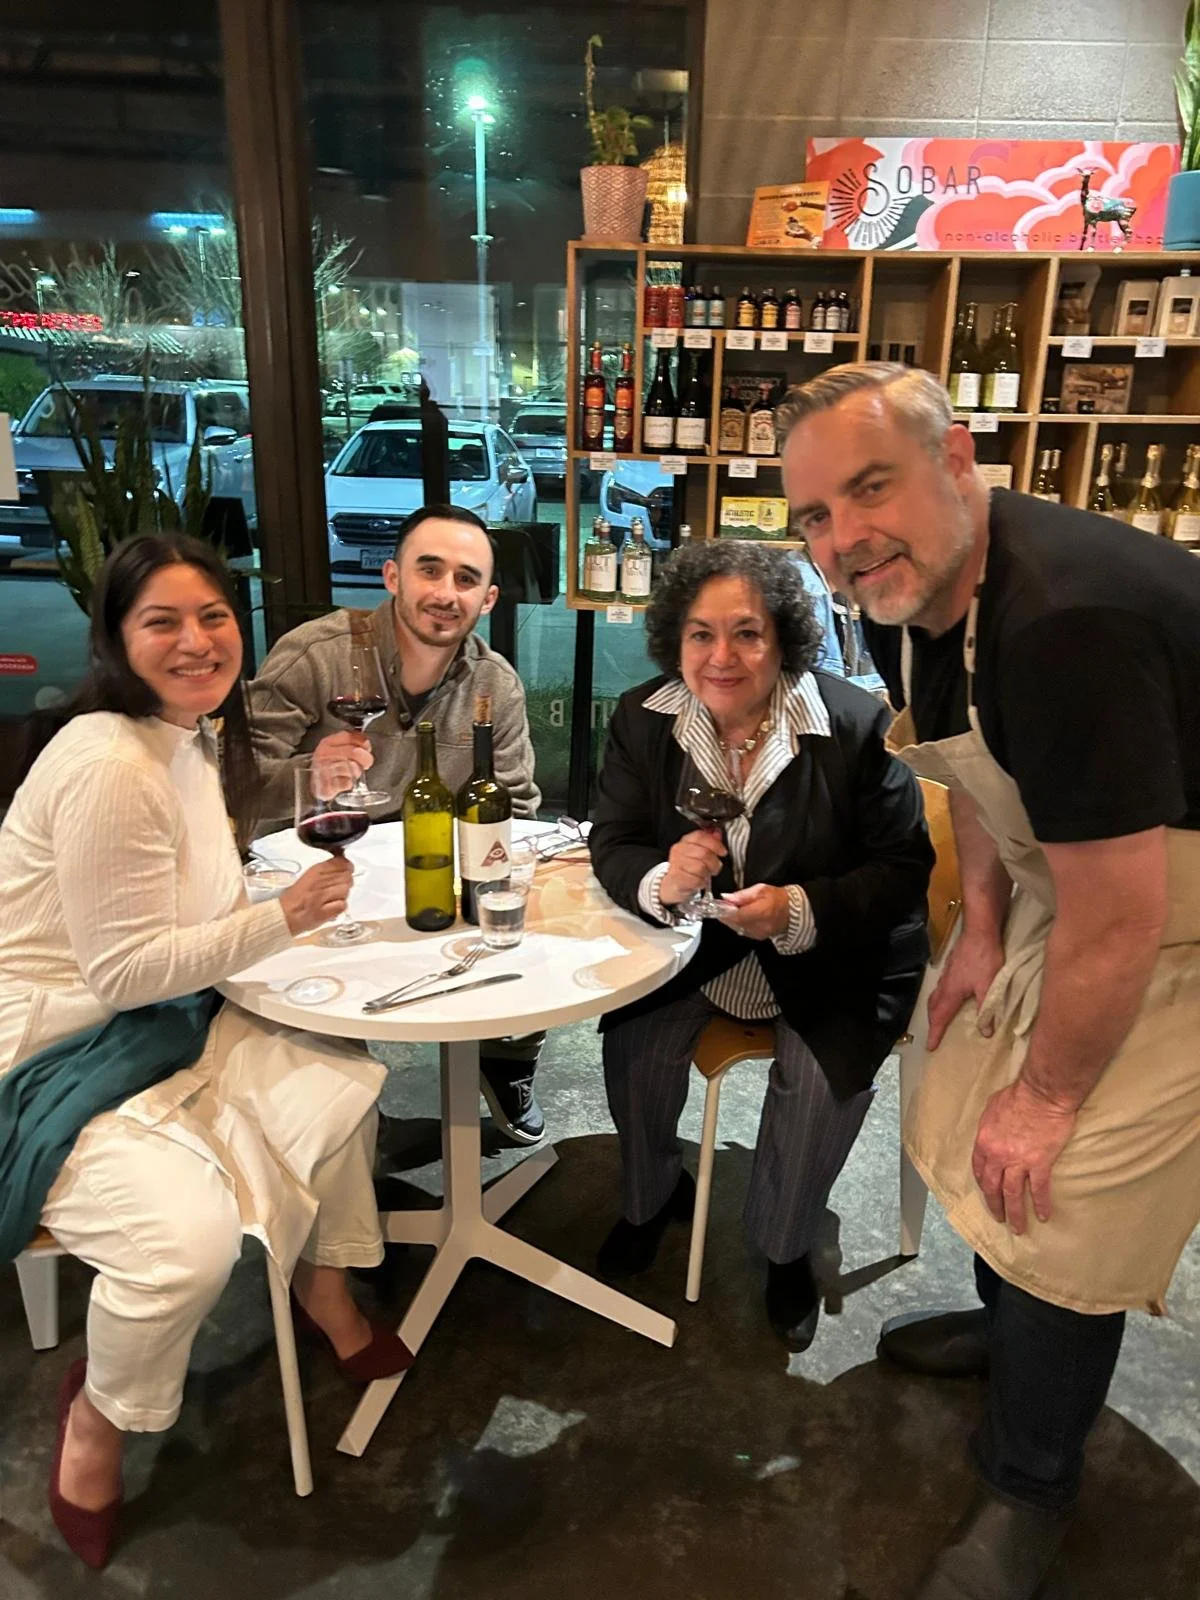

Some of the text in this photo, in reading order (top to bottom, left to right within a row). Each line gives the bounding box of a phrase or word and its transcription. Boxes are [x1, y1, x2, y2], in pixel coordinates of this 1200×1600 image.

[857, 162, 981, 217] SOBAR
[944, 231, 1062, 243] non-alcoholic
[1068, 231, 1120, 244] btle
